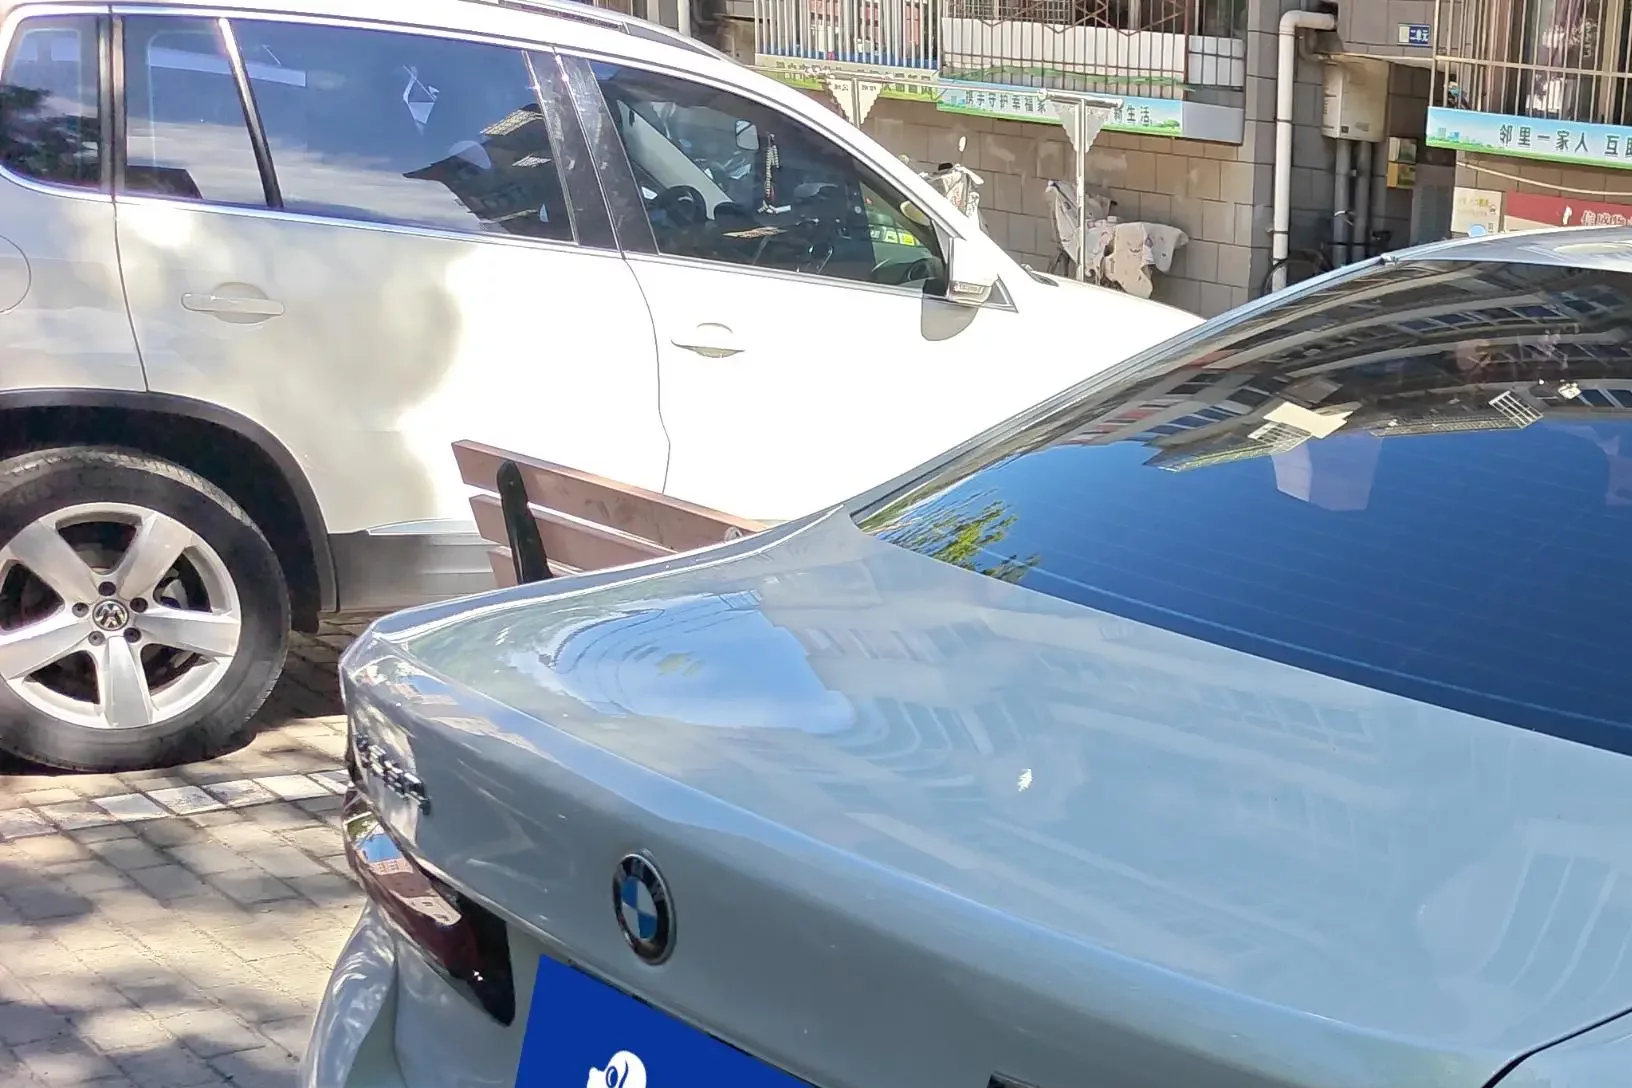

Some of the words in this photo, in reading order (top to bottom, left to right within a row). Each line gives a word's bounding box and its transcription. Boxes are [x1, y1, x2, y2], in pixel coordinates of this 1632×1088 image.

[1499, 123, 1589, 152] 邻里一家人
